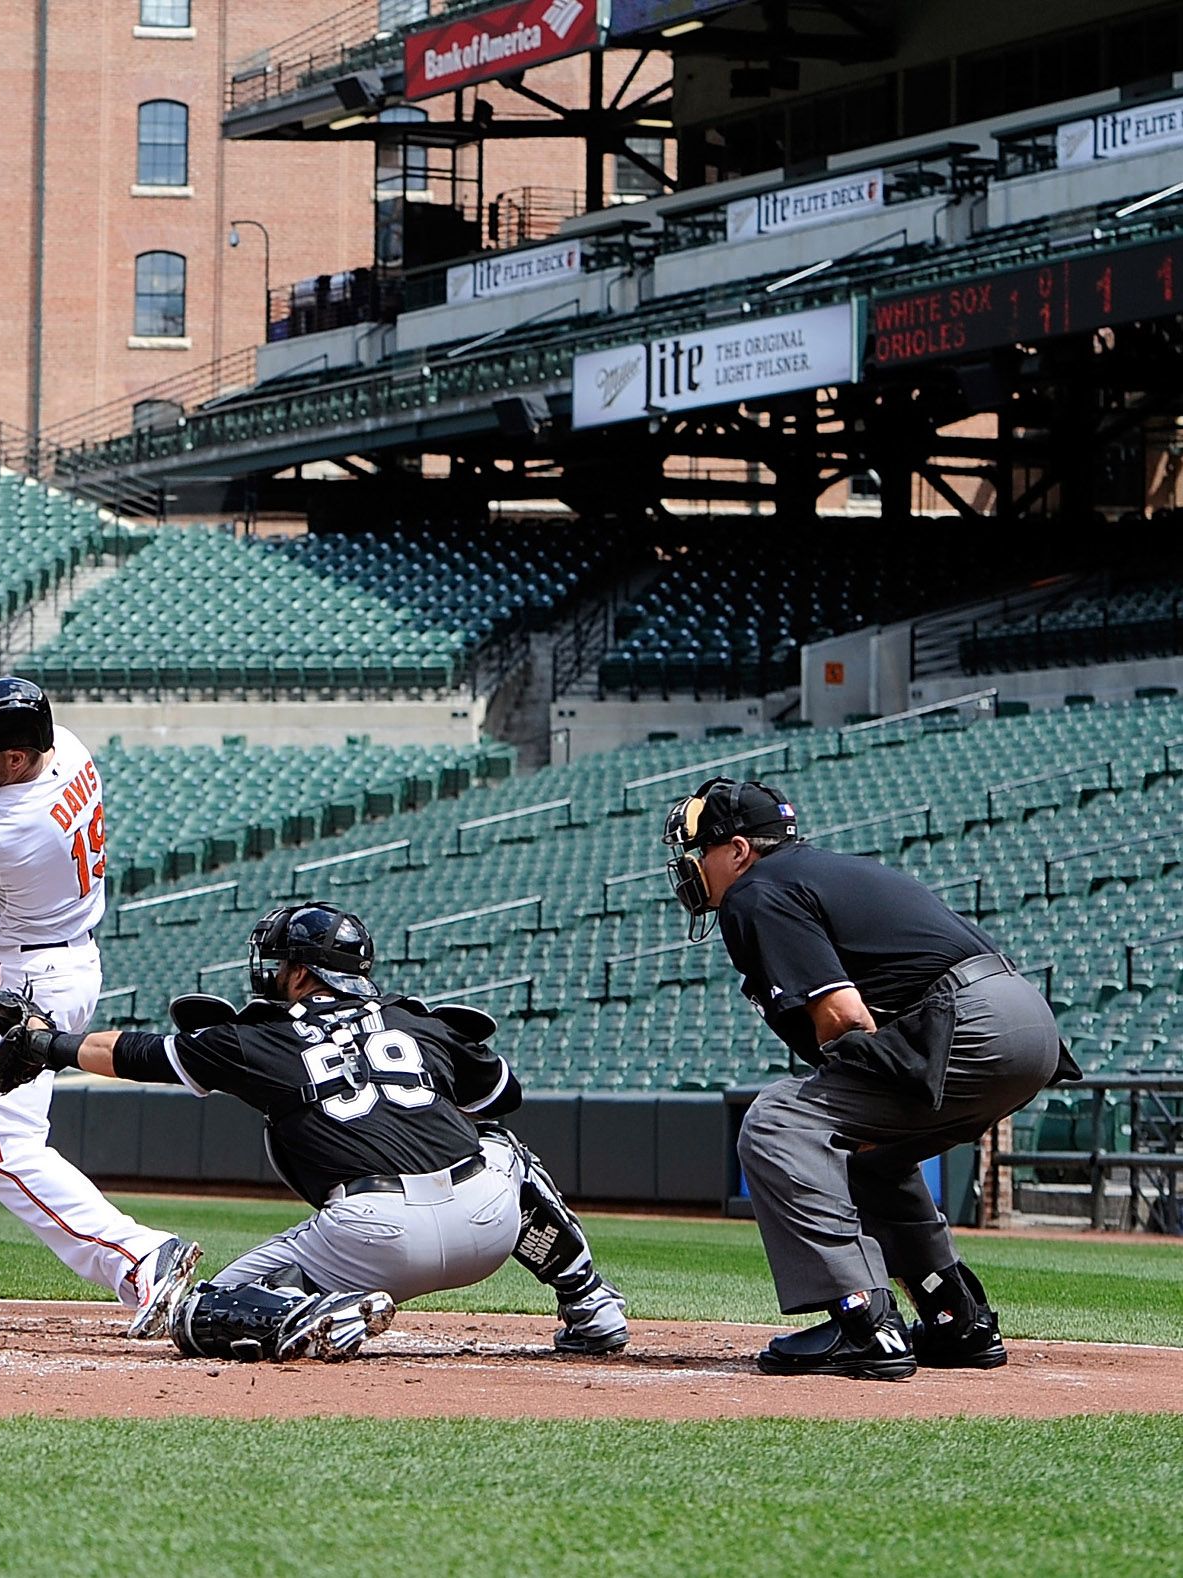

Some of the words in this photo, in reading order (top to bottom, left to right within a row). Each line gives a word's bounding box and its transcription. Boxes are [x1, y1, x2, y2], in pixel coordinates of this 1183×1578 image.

[425, 41, 463, 80] Bank
[463, 35, 479, 68] of
[479, 22, 542, 64] America
[1135, 112, 1176, 138] FLITE
[792, 193, 828, 216] FLITE
[831, 184, 866, 208] DECK
[503, 261, 534, 281] FLITE
[536, 254, 564, 274] DECK
[875, 293, 942, 332] WHITE
[949, 284, 993, 318] SOX
[716, 344, 741, 363] THE
[744, 329, 806, 359] ORIGINAL
[875, 322, 968, 362] ORIOLES
[714, 362, 753, 386] LIGHT
[50, 760, 98, 833] DAVIS
[71, 801, 106, 900] 19
[517, 1226, 544, 1258] KNEE
[530, 1225, 560, 1265] SAVER
